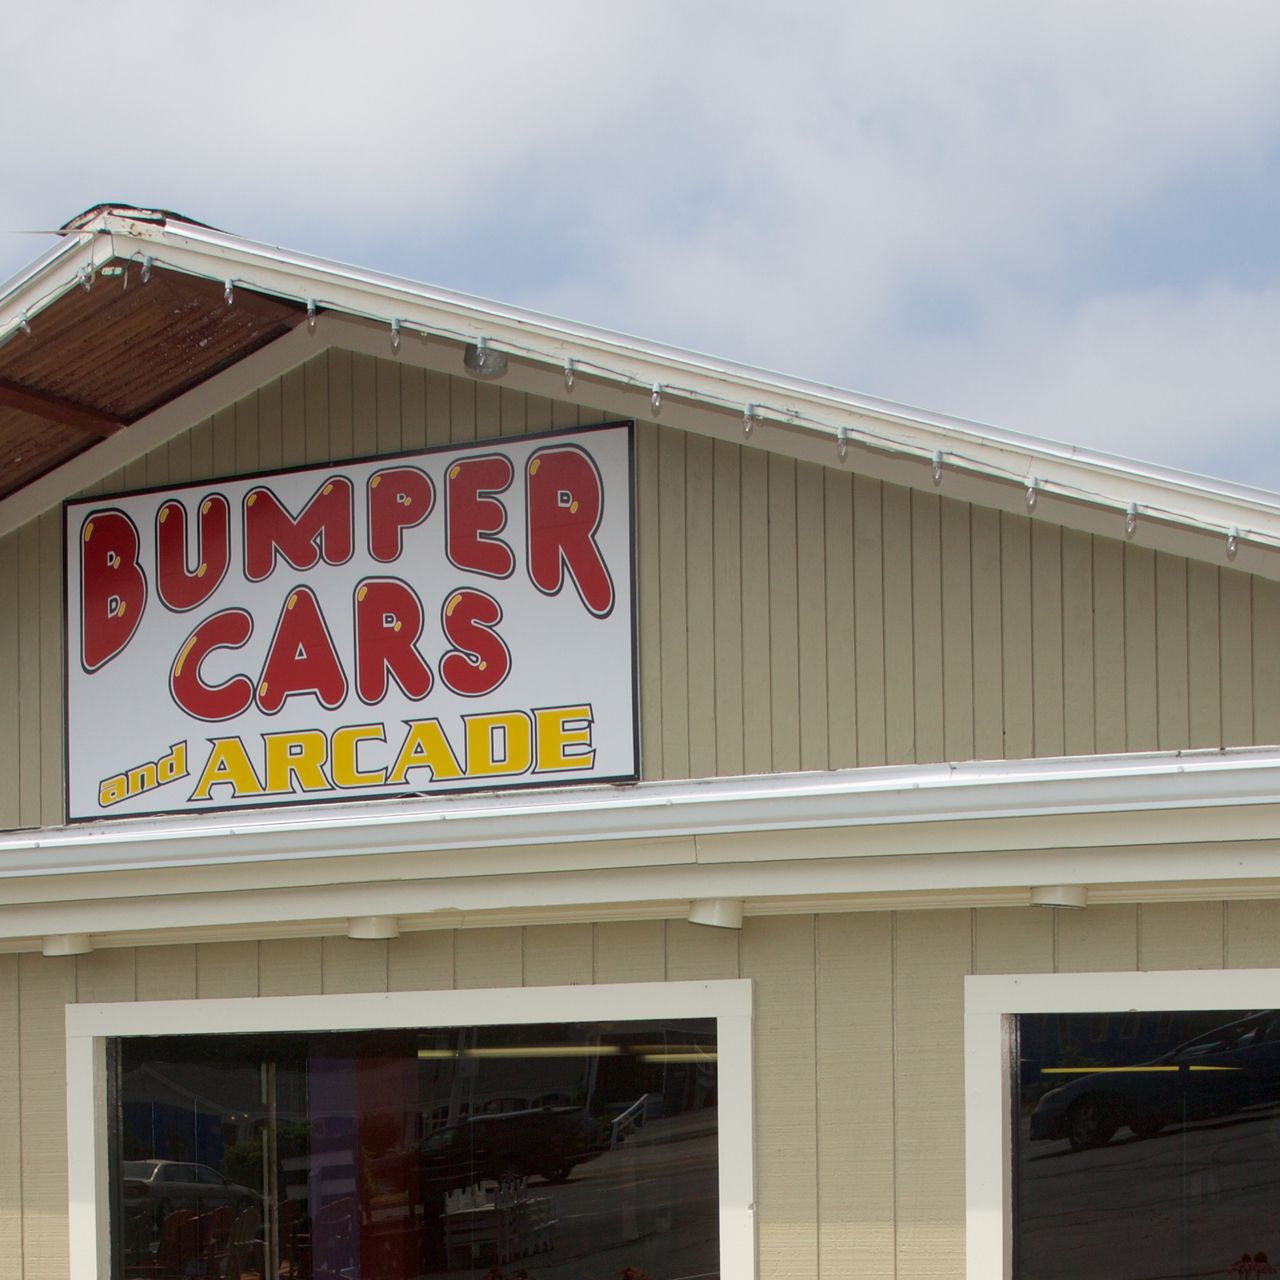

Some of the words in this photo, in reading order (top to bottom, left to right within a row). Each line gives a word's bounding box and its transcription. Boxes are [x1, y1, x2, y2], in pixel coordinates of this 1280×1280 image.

[80, 442, 615, 675] BUMPER
[169, 576, 513, 723] CARS
[98, 739, 189, 808] and
[187, 703, 597, 803] ARCADE
